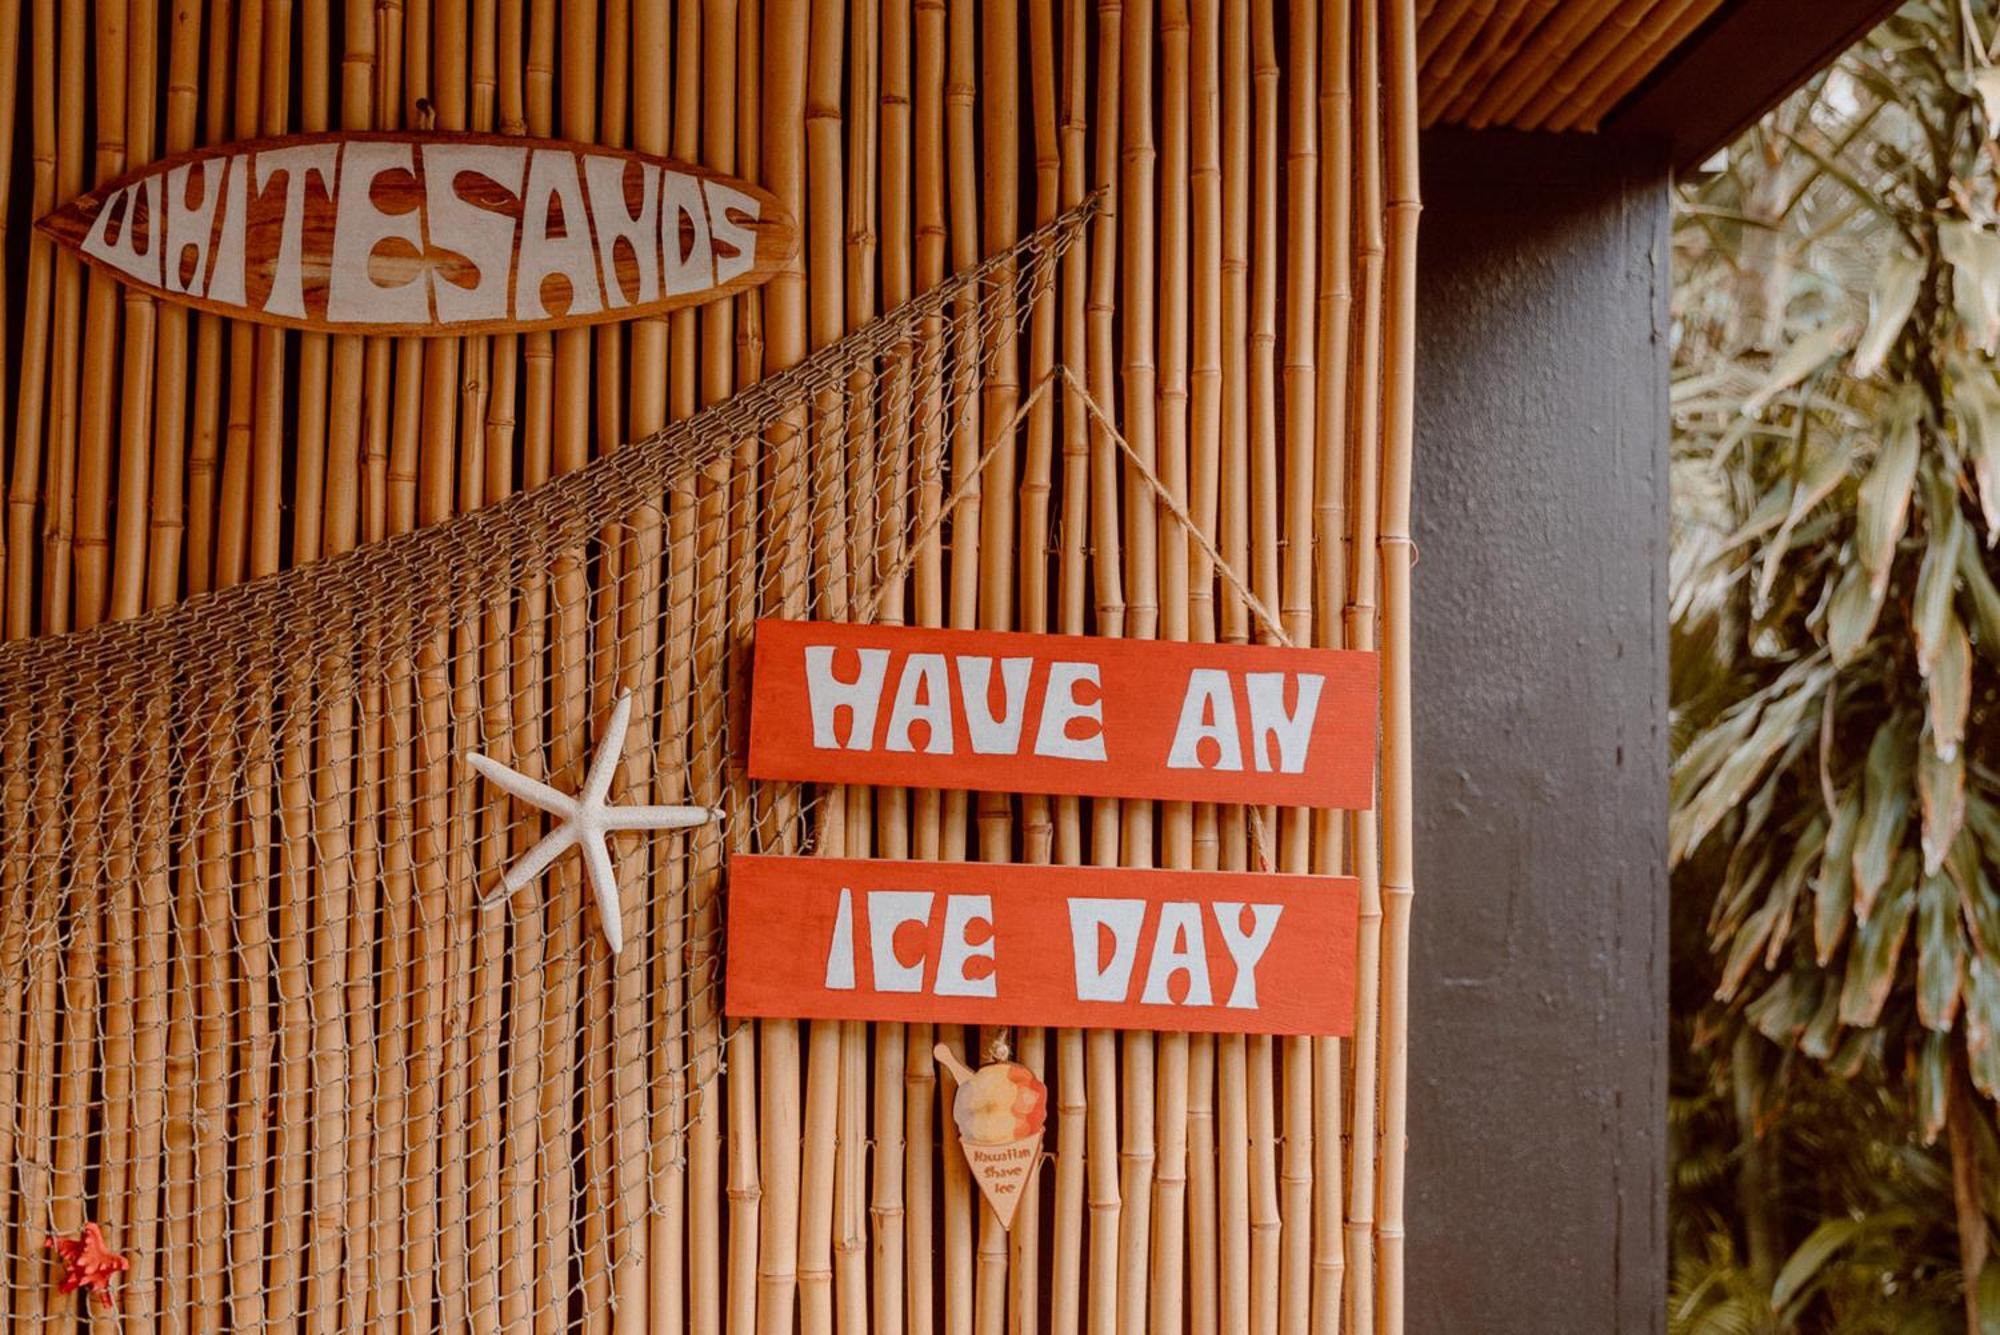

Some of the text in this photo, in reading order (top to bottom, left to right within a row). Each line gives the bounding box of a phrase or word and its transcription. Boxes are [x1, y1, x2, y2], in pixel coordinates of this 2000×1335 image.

[804, 645, 1325, 774] HAVE AN
[825, 887, 1285, 1010] ICE DAY
[973, 1148, 1031, 1163] Hawaiian
[983, 1165, 1023, 1179] Shave
